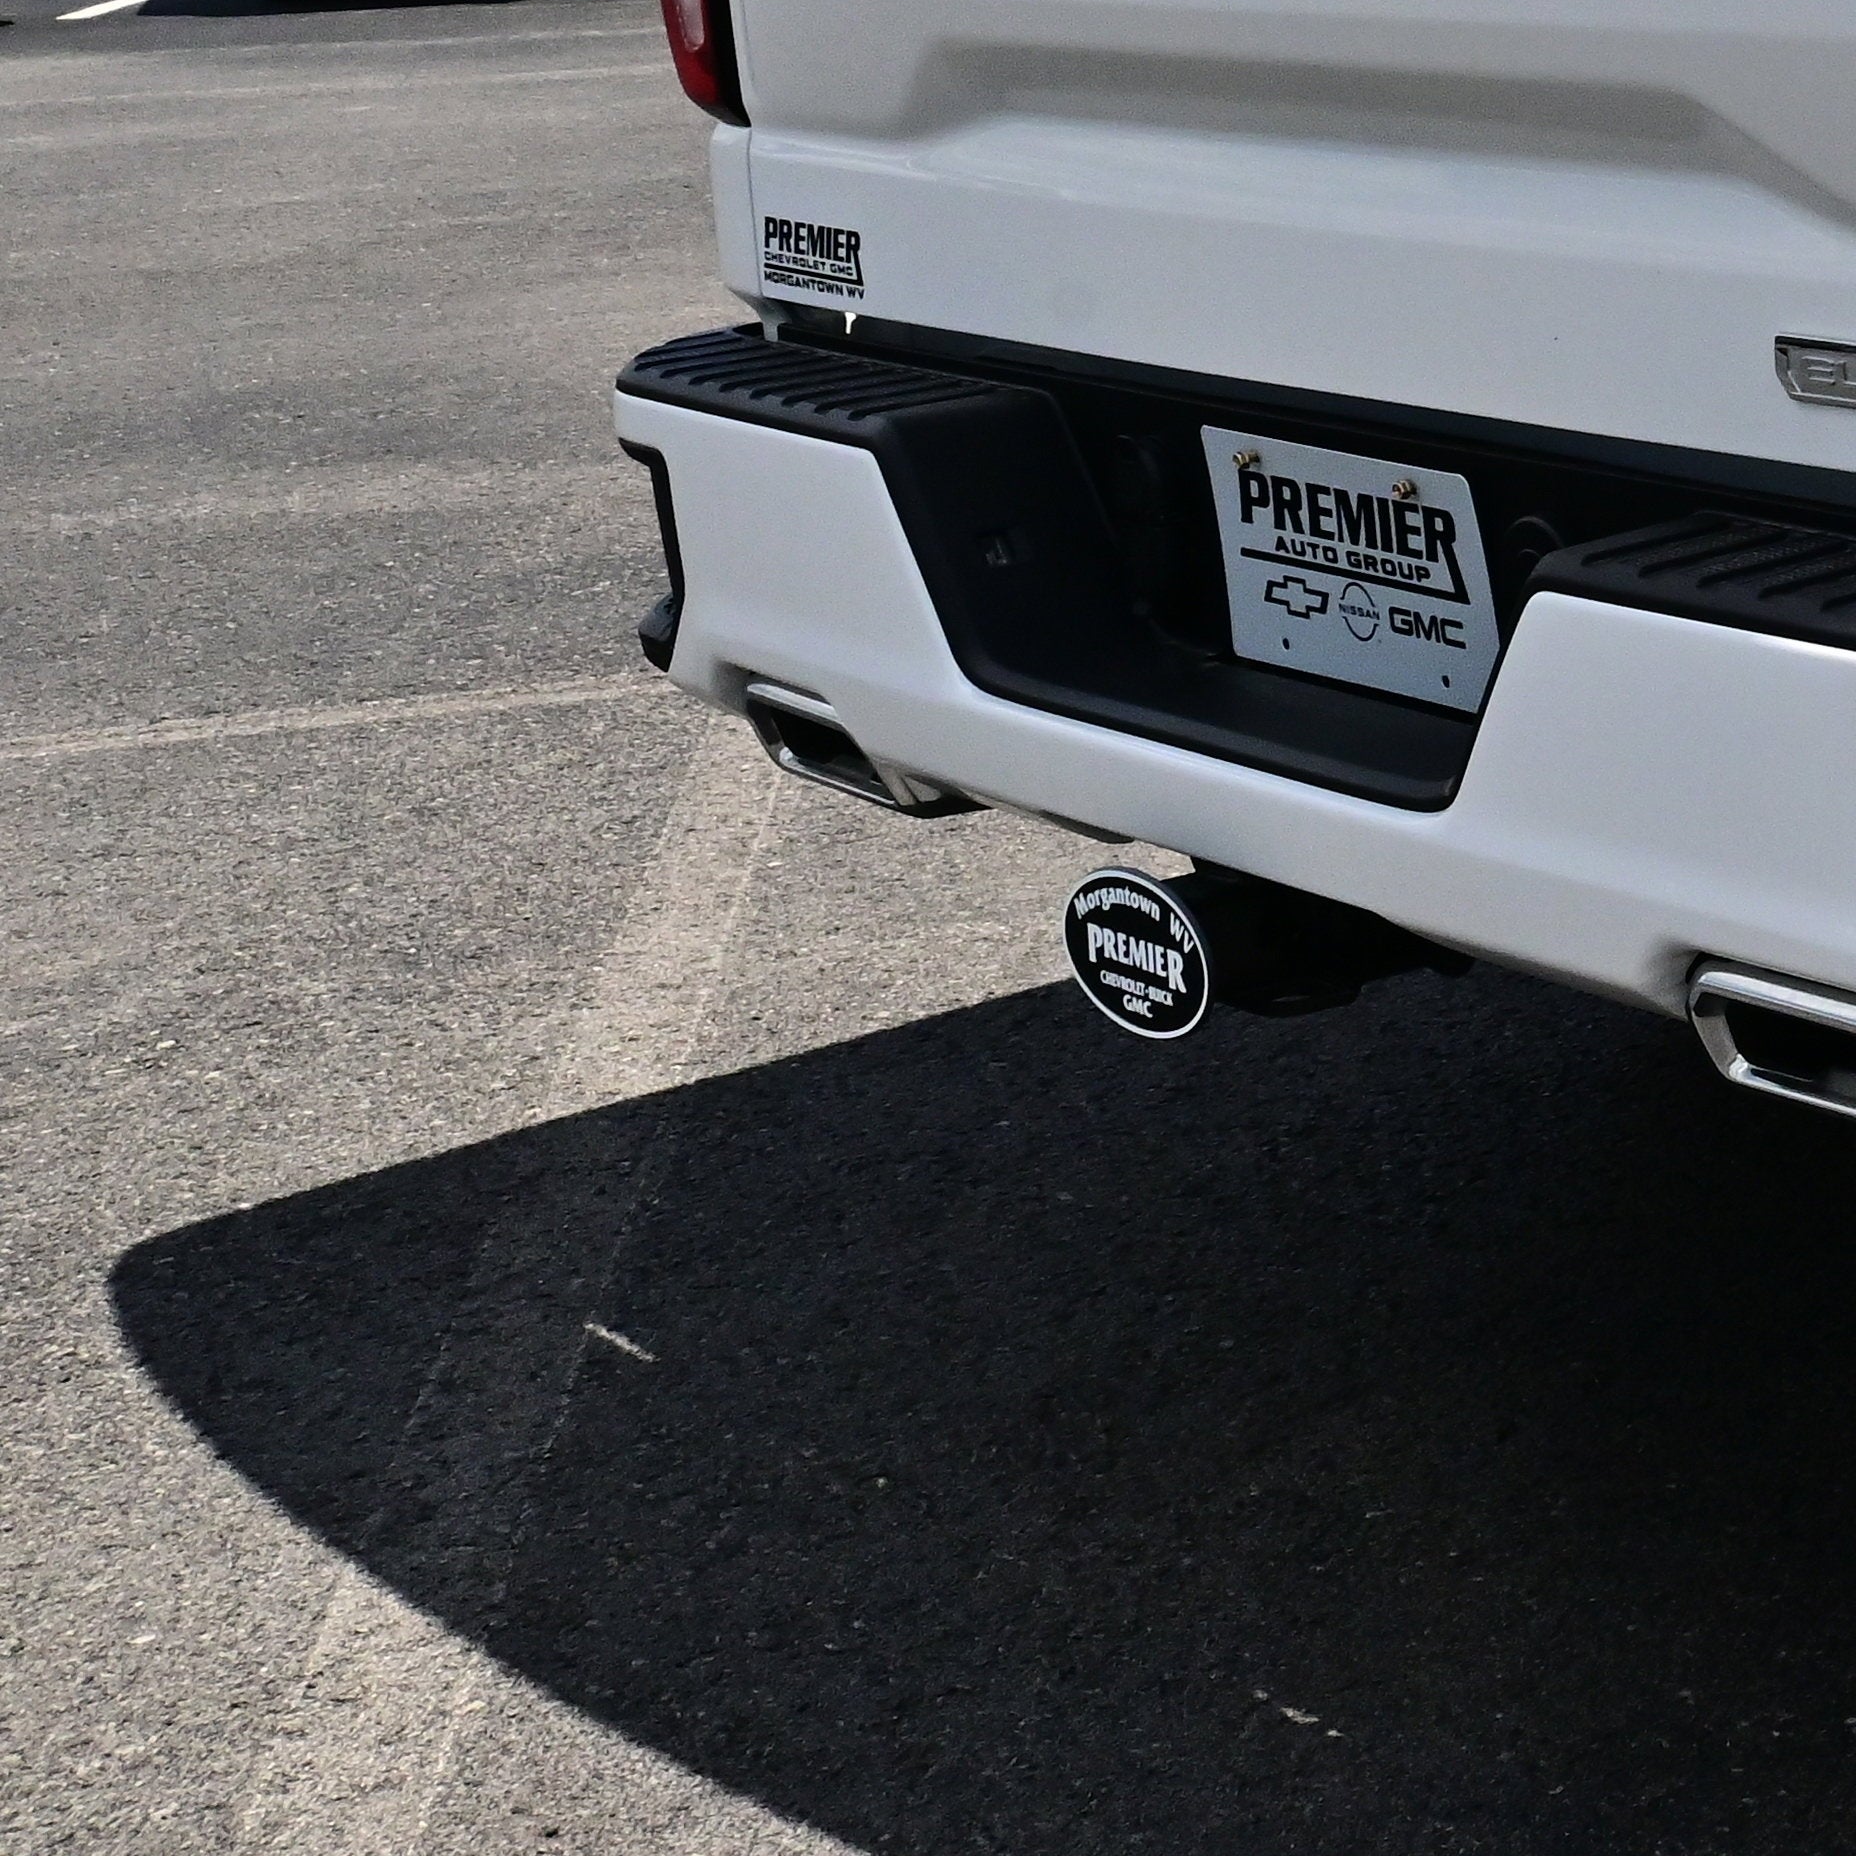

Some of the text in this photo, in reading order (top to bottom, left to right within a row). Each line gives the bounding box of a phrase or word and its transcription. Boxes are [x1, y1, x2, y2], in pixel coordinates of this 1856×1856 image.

[763, 215, 863, 270] PREMIER
[764, 250, 854, 277] CHEVROLET GMC
[763, 269, 866, 300] MORGANTOWN WV
[1238, 466, 1458, 574] PREMIER
[1274, 534, 1432, 584] AUTO GROUP
[1338, 602, 1380, 622] NISSAN
[1388, 605, 1467, 651] GMC
[1073, 885, 1196, 954] Morgantown WV
[1086, 921, 1188, 995] PREMIER
[1123, 994, 1154, 1019] GMC
